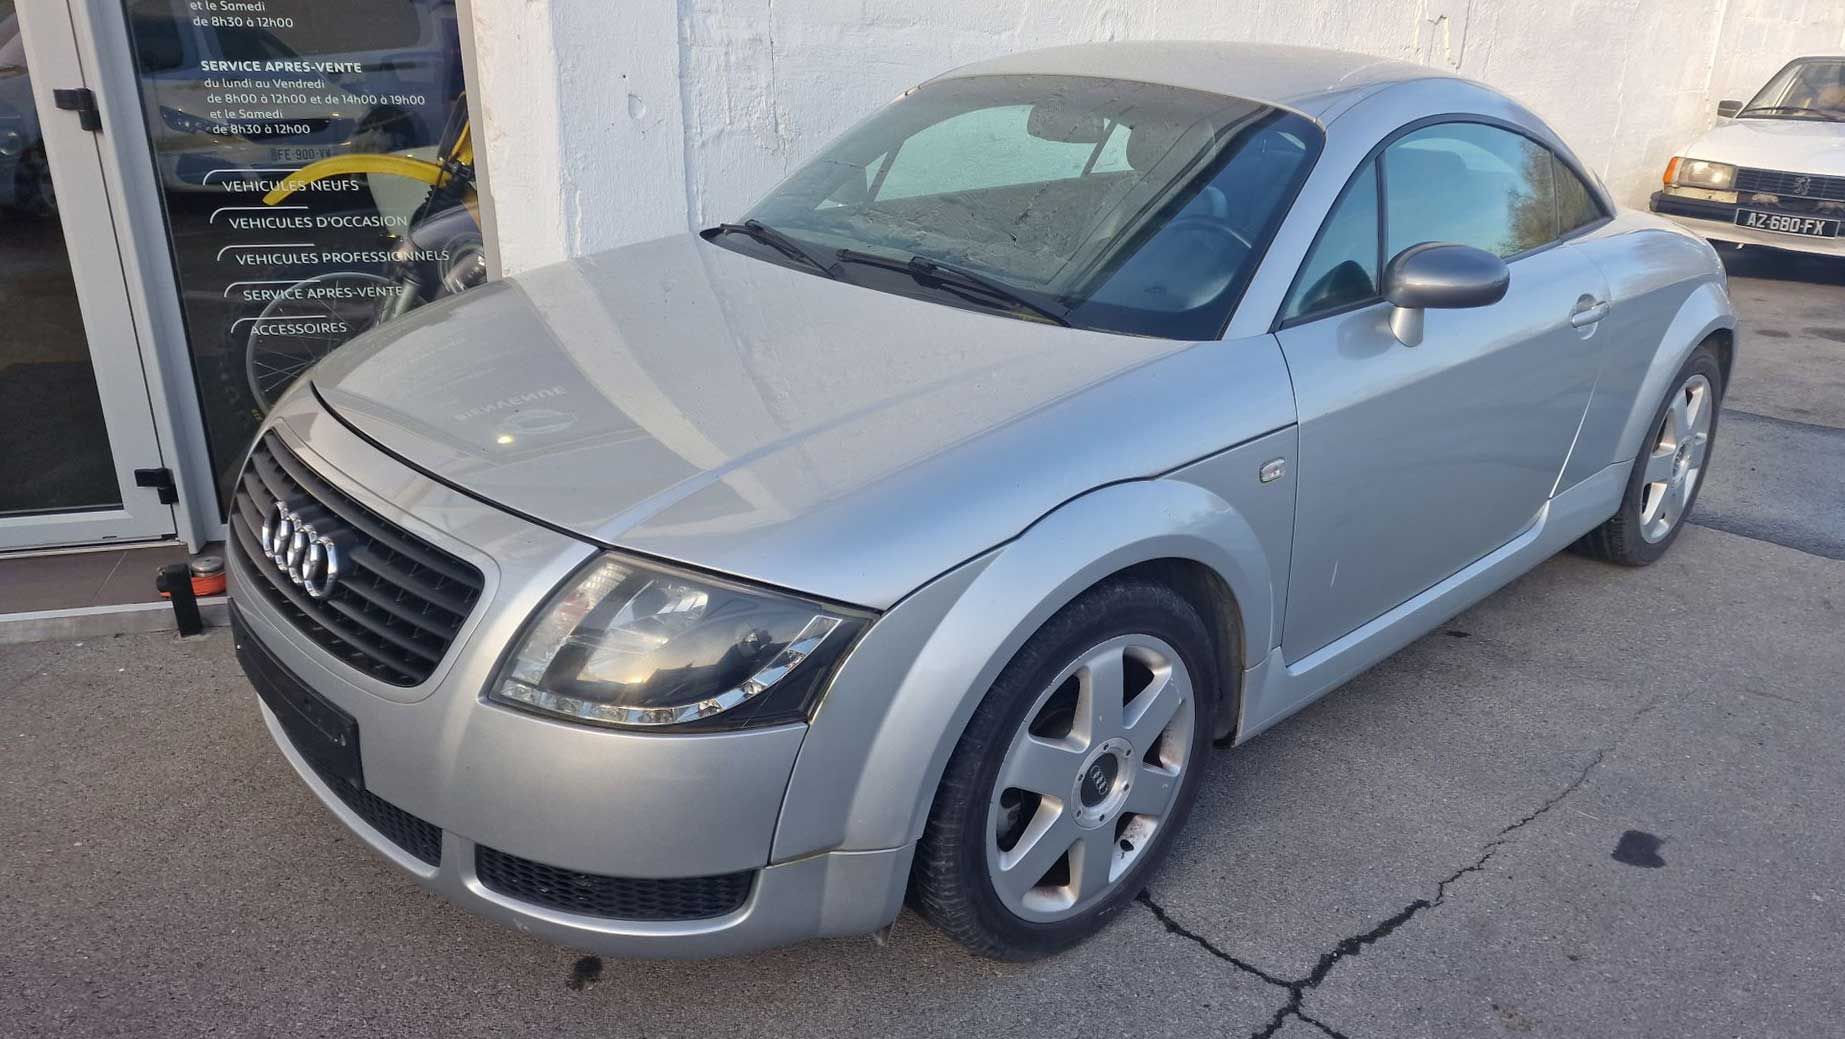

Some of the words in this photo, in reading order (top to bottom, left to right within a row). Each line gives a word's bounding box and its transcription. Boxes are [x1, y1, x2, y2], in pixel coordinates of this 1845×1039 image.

[190, 1, 202, 10] et
[205, 0, 217, 11] le
[219, 0, 266, 12] Samedi
[193, 16, 209, 27] de
[211, 16, 243, 28] 8h30
[246, 17, 254, 28] à
[256, 17, 294, 28] 12h00
[200, 60, 261, 72] SERVICE
[265, 61, 362, 73] APRES-VENTE
[204, 78, 220, 88] du
[223, 78, 252, 88] lundi
[255, 80, 270, 89] au
[272, 79, 325, 89] Vendredi
[207, 93, 222, 104] de
[224, 93, 257, 104] 8h00
[260, 94, 268, 104] à
[270, 94, 307, 104] 12h00
[310, 96, 322, 105] et
[325, 94, 339, 105] de
[341, 94, 377, 105] 14h00
[380, 94, 388, 105] à
[390, 95, 425, 106] 19h00
[210, 110, 222, 119] et
[225, 108, 236, 119] le
[238, 109, 283, 119] Samedi
[213, 124, 228, 134] de
[230, 124, 261, 134] 8h30
[264, 125, 272, 134] à
[274, 125, 311, 134] 12h00
[222, 180, 306, 192] VEHICULES
[311, 180, 359, 191] NEUFS
[229, 217, 313, 229] VEHICULES
[316, 216, 407, 228] D'OCCASION
[1747, 212, 1825, 236] AZ-680-FX
[236, 253, 319, 265] VEHICULES
[322, 251, 449, 263] PROFESSIONNELS
[243, 289, 304, 301] SERVICE
[307, 286, 402, 299] APRES-VENTE
[250, 322, 347, 336] ACCESSOIRES
